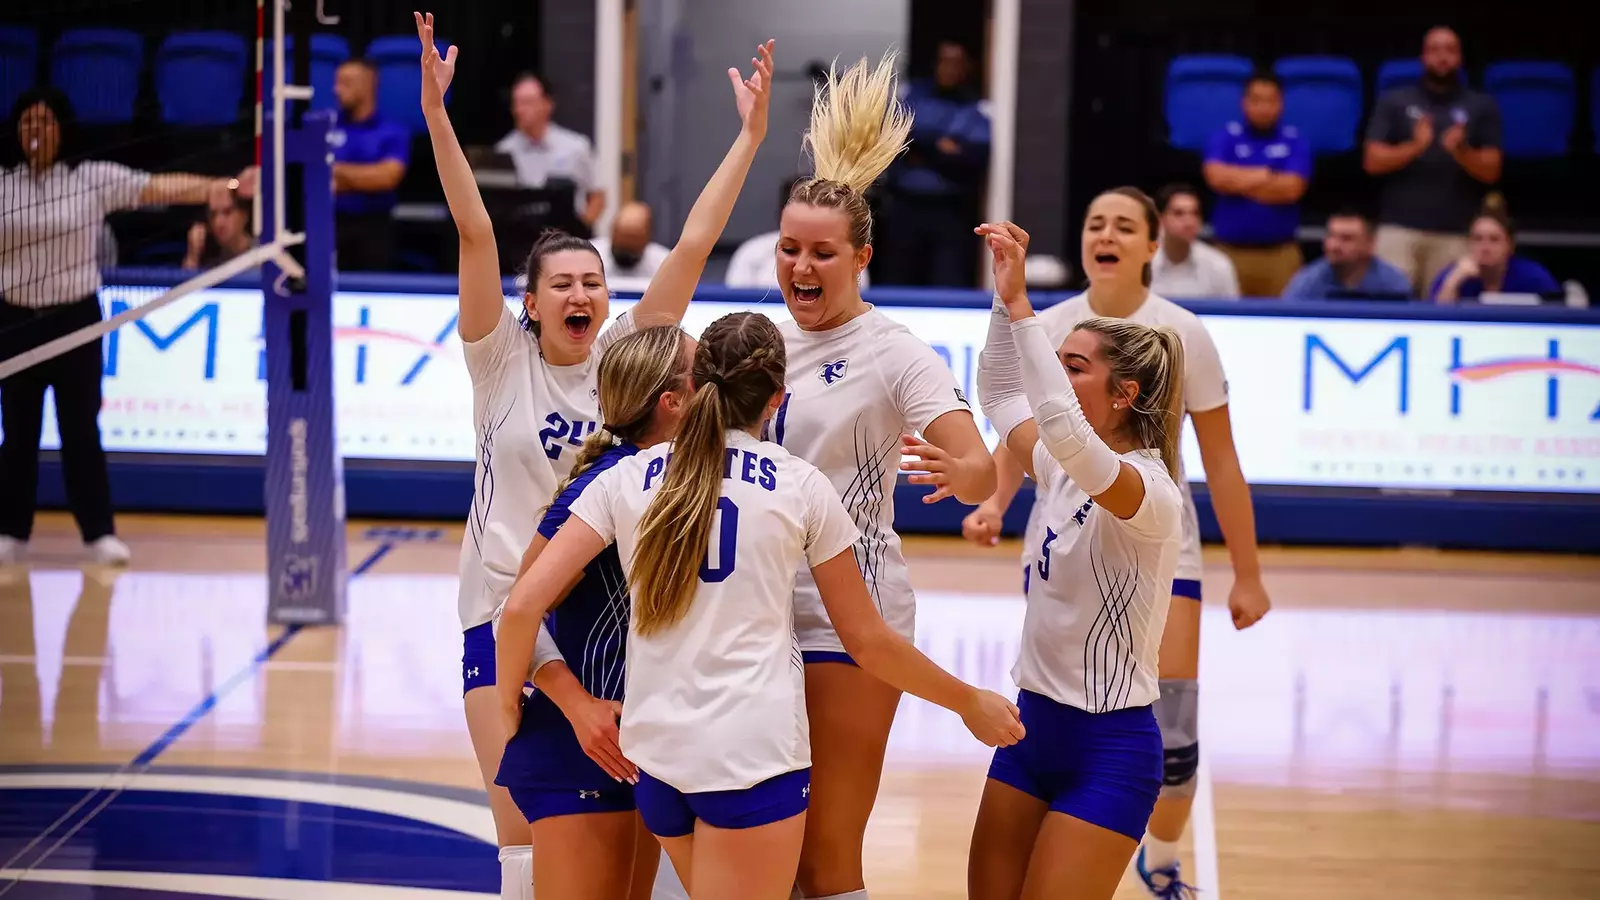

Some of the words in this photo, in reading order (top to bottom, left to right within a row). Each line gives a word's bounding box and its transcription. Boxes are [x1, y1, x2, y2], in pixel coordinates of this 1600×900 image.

[1303, 333, 1600, 420] MH
[539, 412, 597, 461] 24
[643, 447, 777, 492] PTES
[1037, 526, 1058, 582] 5
